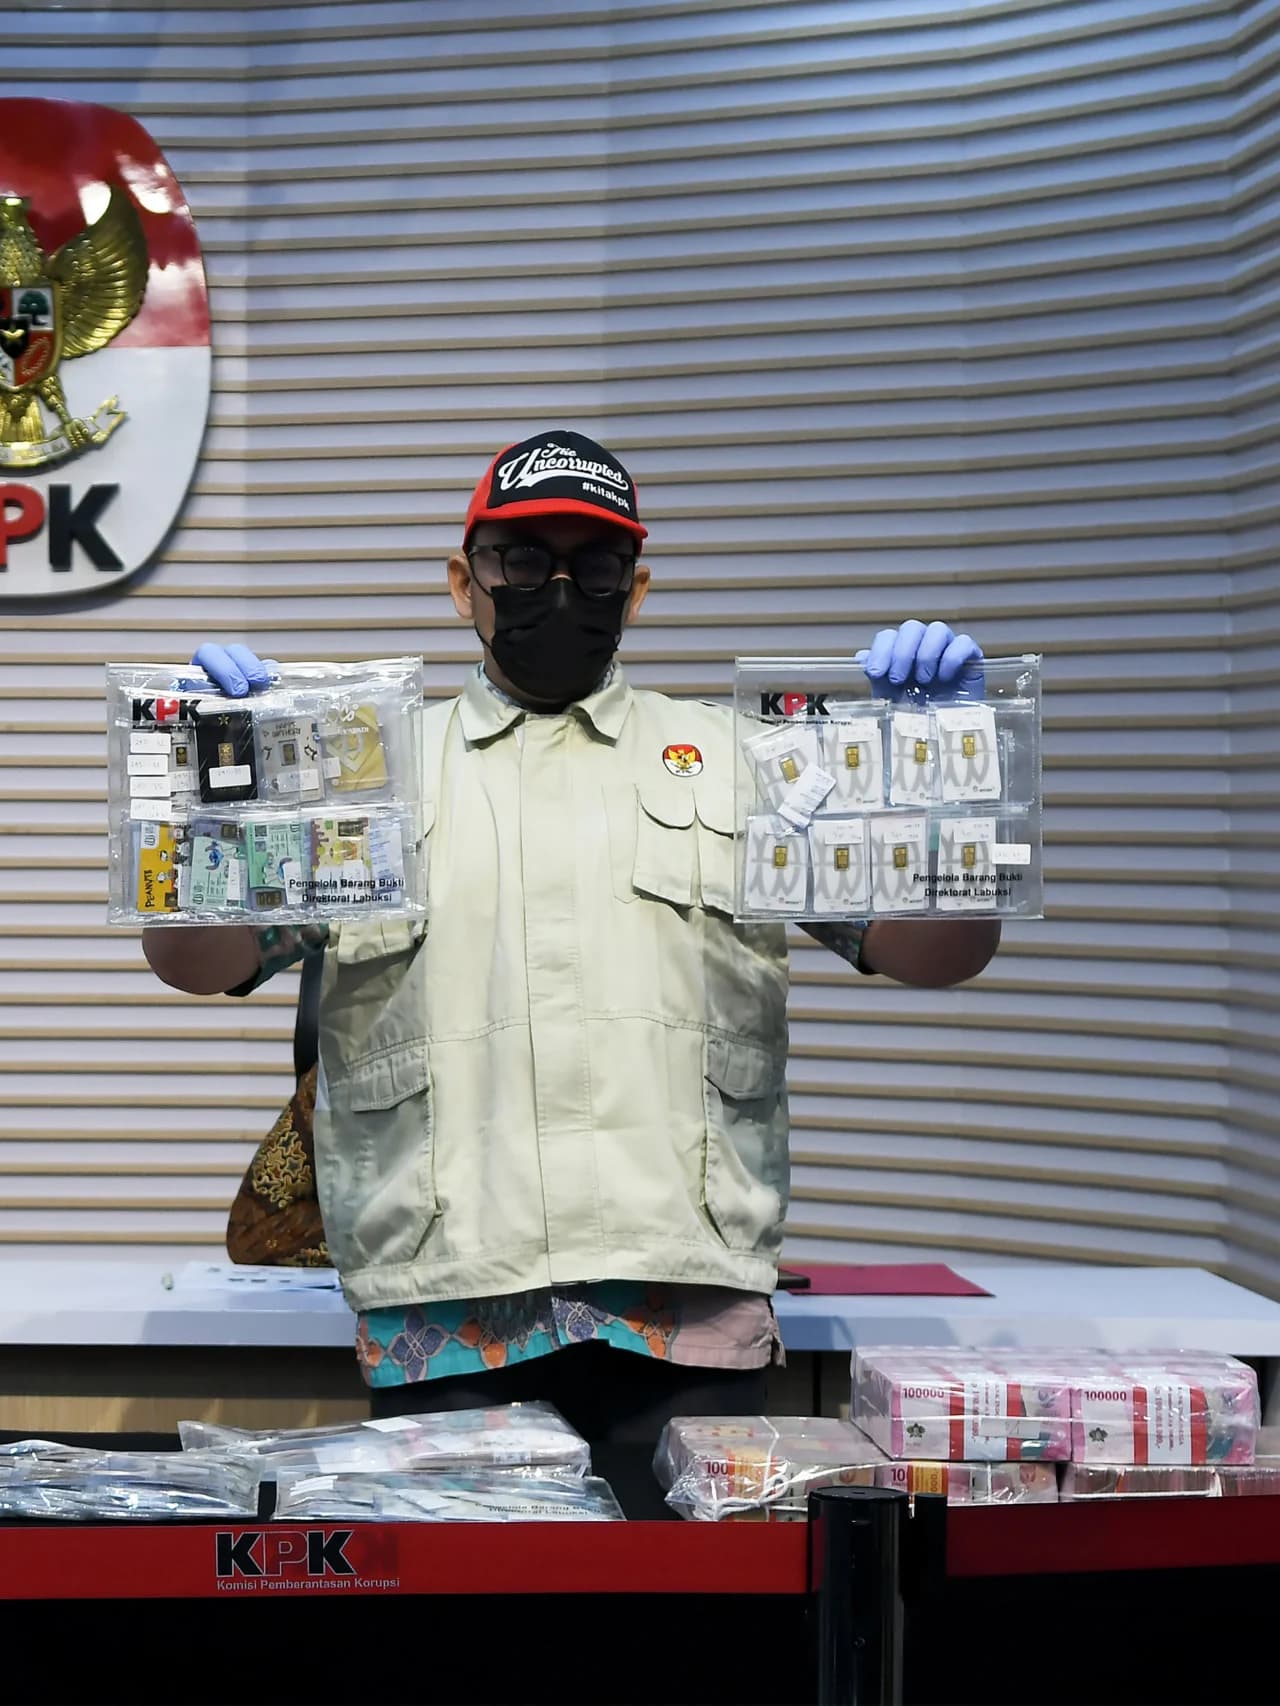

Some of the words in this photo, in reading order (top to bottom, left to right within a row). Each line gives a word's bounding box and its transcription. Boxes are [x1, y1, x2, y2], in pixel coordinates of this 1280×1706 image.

[541, 443, 577, 459] The
[498, 448, 629, 491] Uncorrupted
[582, 482, 630, 511] #kitakpk
[132, 698, 201, 722] KPK
[761, 693, 830, 716] KPK
[289, 879, 338, 889] Pengelola
[341, 879, 376, 889] Barang
[379, 879, 405, 888] Bukti
[913, 873, 960, 883] Pengelola
[963, 873, 996, 883] Barang
[999, 872, 1023, 882] Bukti
[302, 894, 350, 903] Direktorat
[354, 894, 392, 903] Labuksi
[925, 888, 972, 897] Direktorat
[974, 888, 1012, 897] Labuksi
[903, 1387, 944, 1399] 100000
[1084, 1390, 1127, 1401] 100000
[216, 1529, 357, 1578] KPK
[217, 1580, 257, 1591] Komisi
[260, 1578, 351, 1590] Pemberantasan
[355, 1577, 400, 1590] Korupsi
